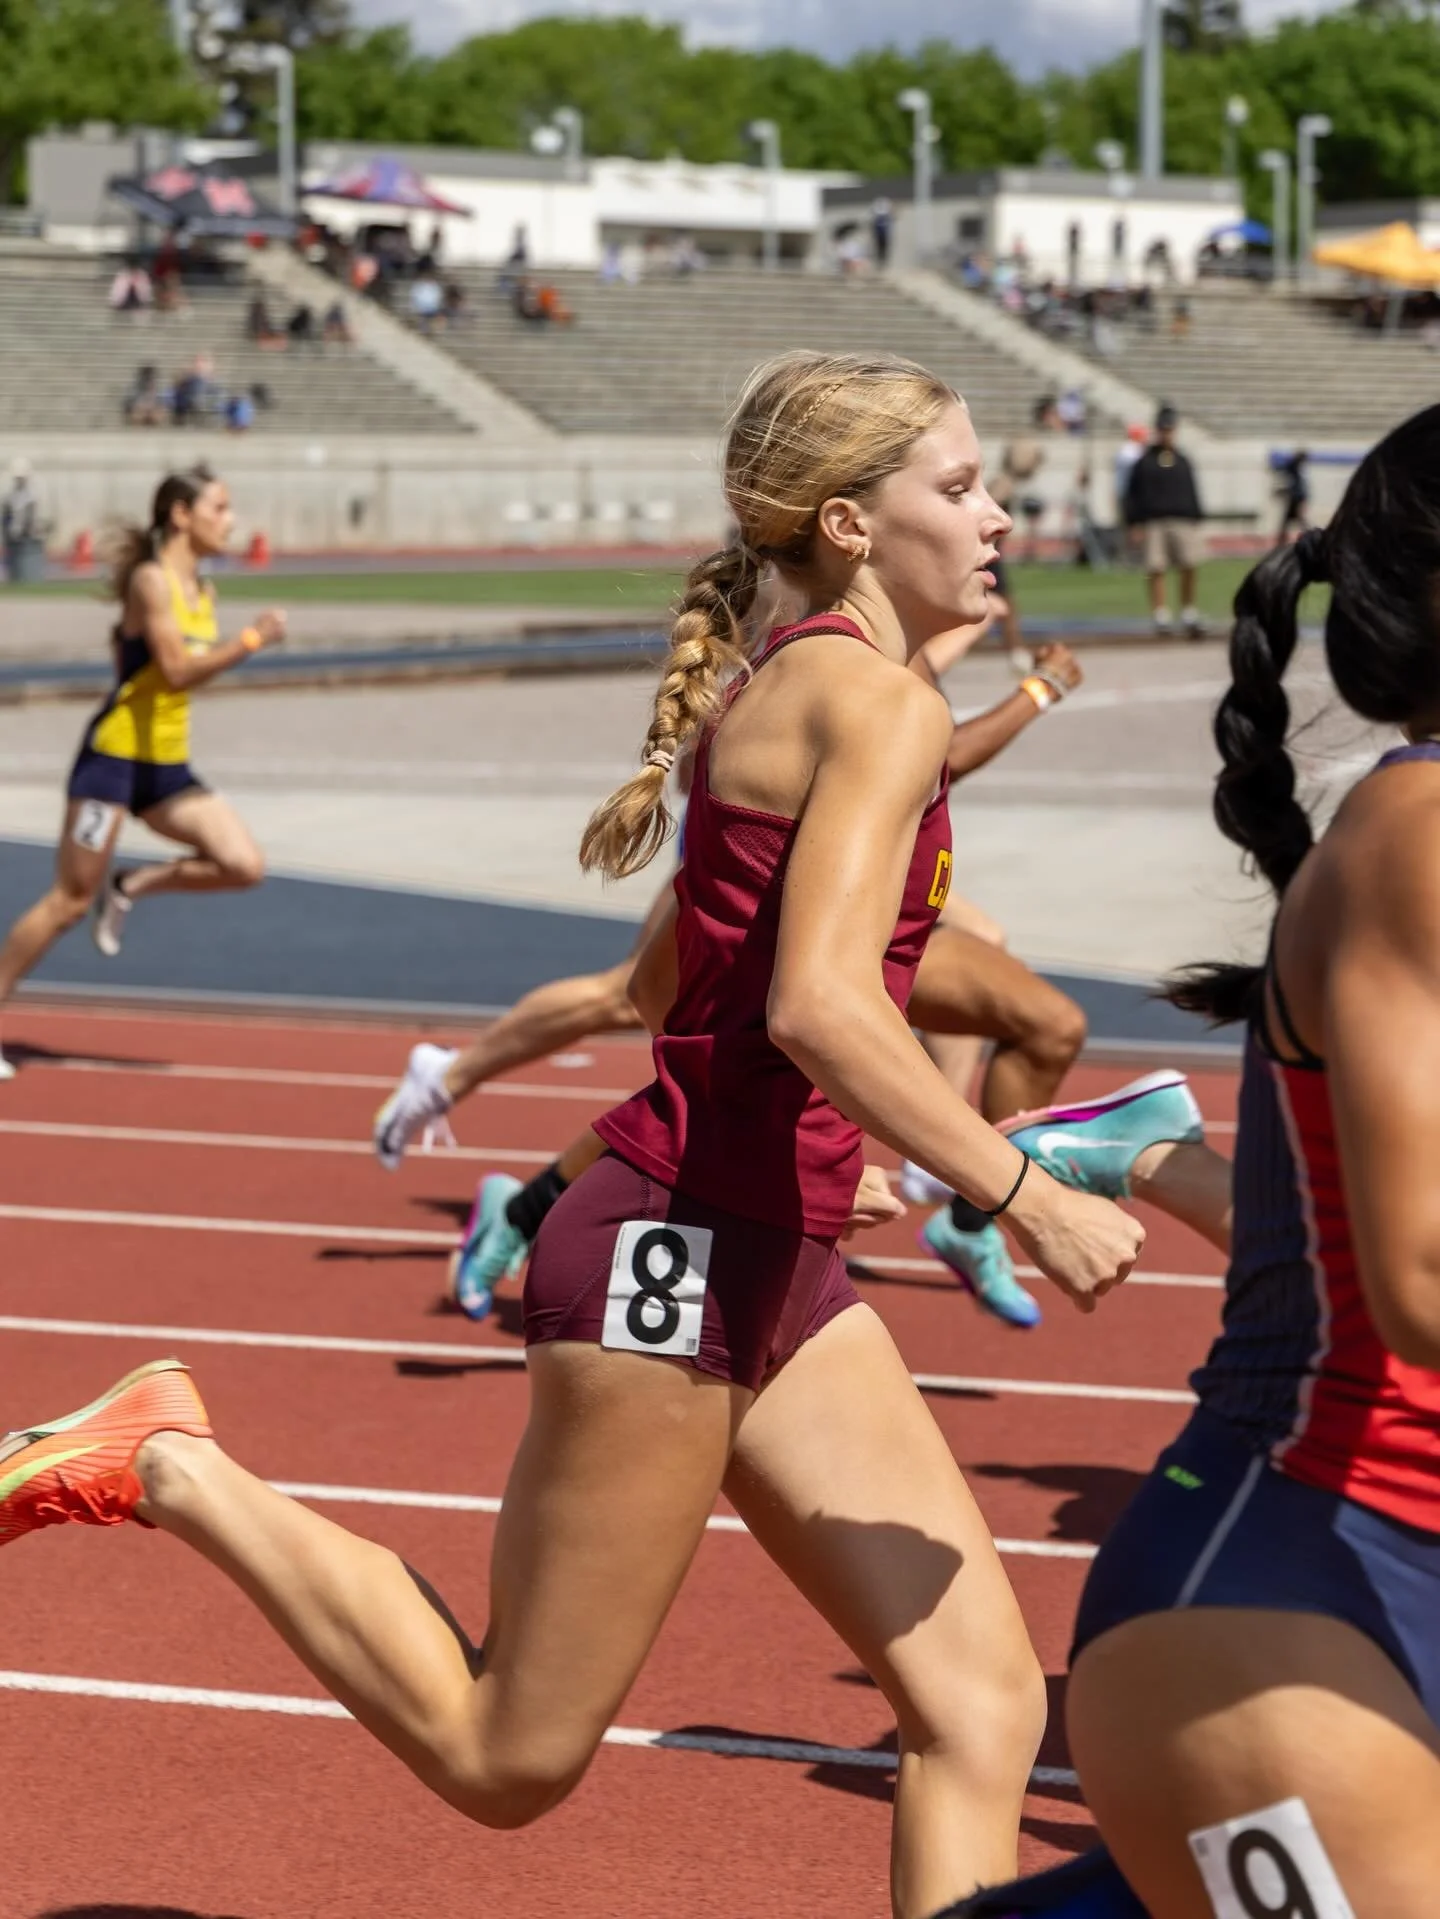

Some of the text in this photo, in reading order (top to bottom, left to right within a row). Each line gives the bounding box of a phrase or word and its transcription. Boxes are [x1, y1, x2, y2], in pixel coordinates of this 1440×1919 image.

[80, 808, 104, 847] 2
[927, 848, 952, 910] C
[626, 1228, 689, 1345] 8
[1227, 1828, 1319, 1919] 9
